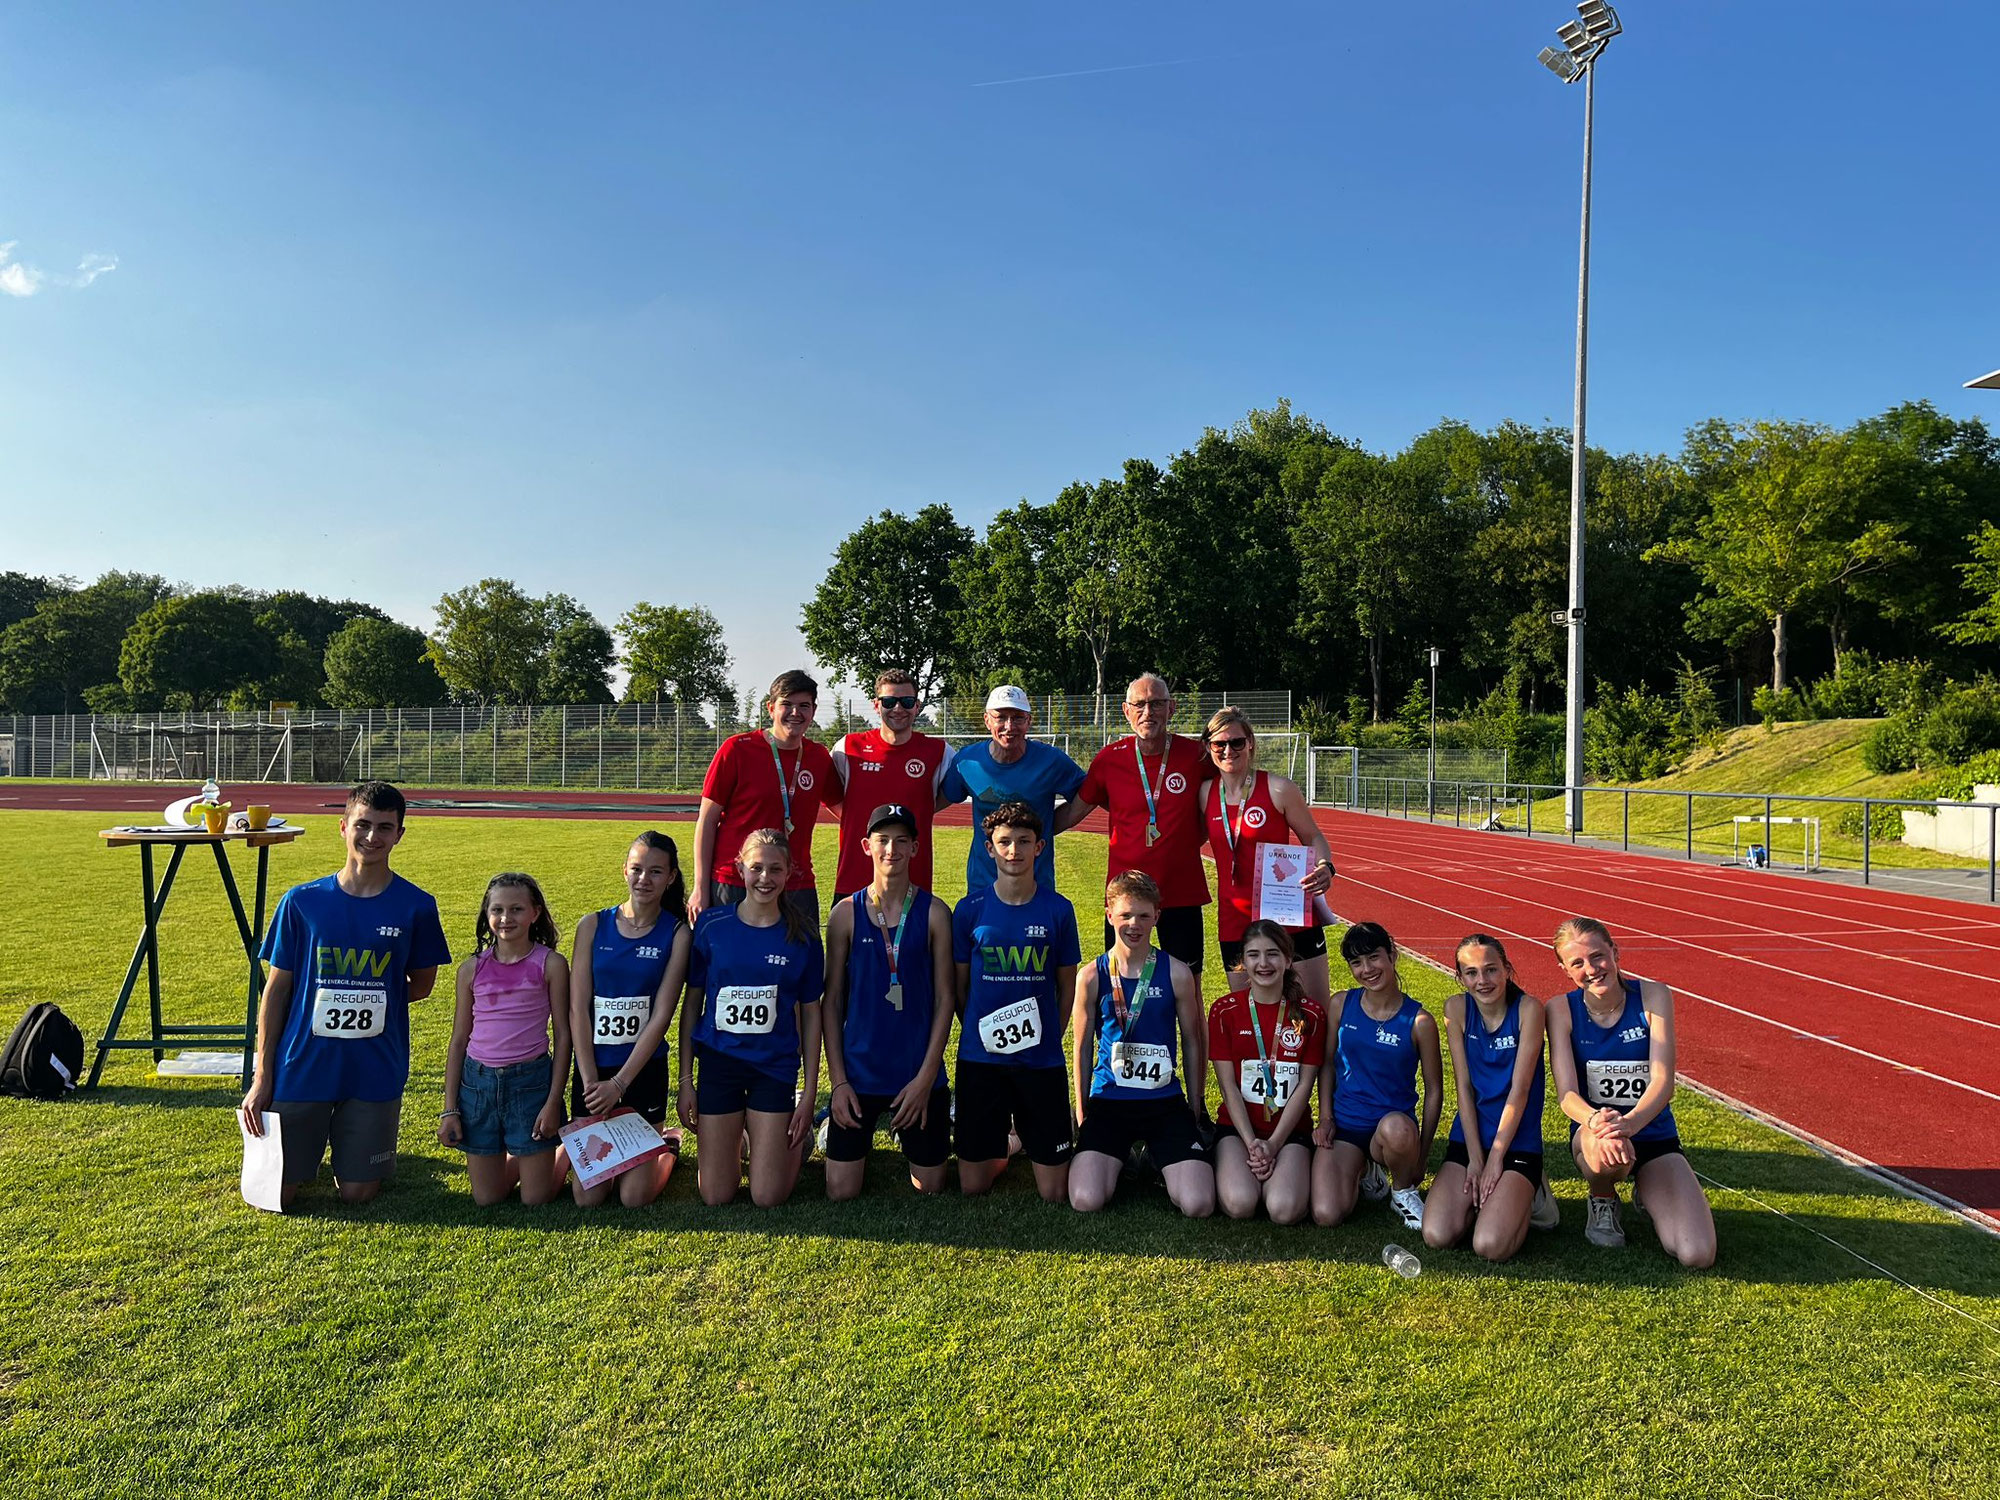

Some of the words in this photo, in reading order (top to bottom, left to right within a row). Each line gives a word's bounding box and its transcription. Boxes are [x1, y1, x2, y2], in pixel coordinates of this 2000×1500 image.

[909, 764, 921, 773] SV
[1170, 779, 1182, 788] SV
[1249, 812, 1261, 822] SV
[1268, 851, 1301, 860] URKUNDE
[316, 946, 392, 978] EWV
[980, 945, 1050, 973] EWV
[333, 993, 384, 1004] REGUPOL
[731, 989, 778, 1000] REGUPOL
[604, 1000, 649, 1011] REGUPOL
[325, 1008, 373, 1030] 328
[725, 1004, 769, 1026] 349
[992, 1002, 1037, 1024] REGUPOL
[597, 1015, 640, 1037] 339
[992, 1018, 1036, 1049] 334
[1284, 1032, 1298, 1044] SV
[1127, 1045, 1171, 1059] REGUPOL
[1121, 1060, 1161, 1082] 344
[1256, 1063, 1300, 1075] RUPOL
[1604, 1064, 1650, 1074] REGUPO
[1599, 1078, 1647, 1099] 329
[573, 1137, 594, 1172] URKUNDE
